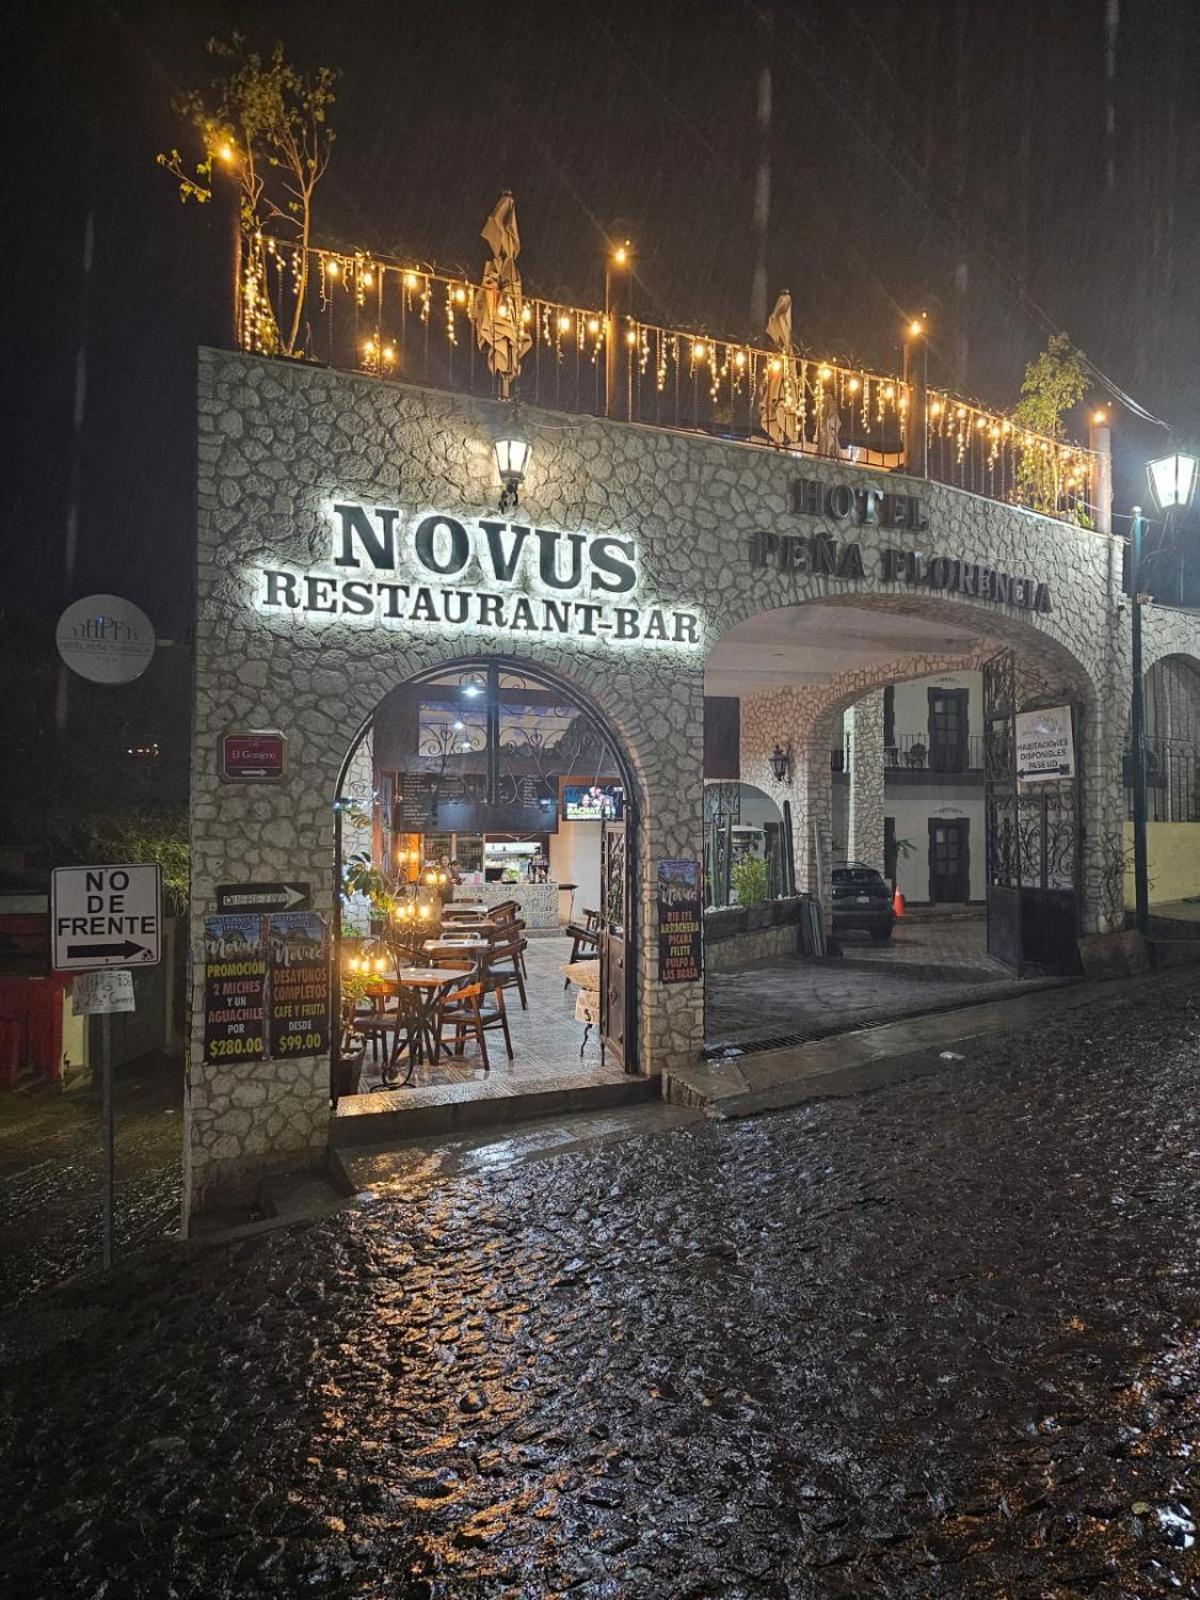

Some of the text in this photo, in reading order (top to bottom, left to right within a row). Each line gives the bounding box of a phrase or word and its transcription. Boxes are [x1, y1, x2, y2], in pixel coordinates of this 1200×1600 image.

[792, 478, 930, 530] HOTEL
[333, 504, 638, 593] NOVUS
[751, 532, 1051, 613] PEÑA FLORENCIA
[262, 570, 701, 643] RESTAURANT-BAR
[1016, 738, 1068, 751] HABITACIONES
[1020, 748, 1066, 761] DISPONIBLES
[85, 871, 130, 892] NO
[87, 894, 125, 914] DE
[57, 916, 156, 936] FRENTE
[660, 922, 699, 934] ARRACHERA
[670, 945, 691, 957] FILETE
[665, 957, 688, 969] PULPO
[273, 968, 327, 985] DESAYUNOS
[662, 969, 676, 980] LAS
[213, 981, 261, 996] 2 MICHES
[273, 984, 327, 1002] COMPLETOS
[227, 996, 247, 1007] Y UN
[208, 1008, 265, 1024] AGUACHILE
[294, 1006, 300, 1017] Y
[301, 1003, 326, 1017] FRUTA
[227, 1024, 245, 1035] POR
[288, 1020, 313, 1032] DESDE
[209, 1037, 264, 1058] $280.00
[279, 1034, 321, 1053] $99.00
